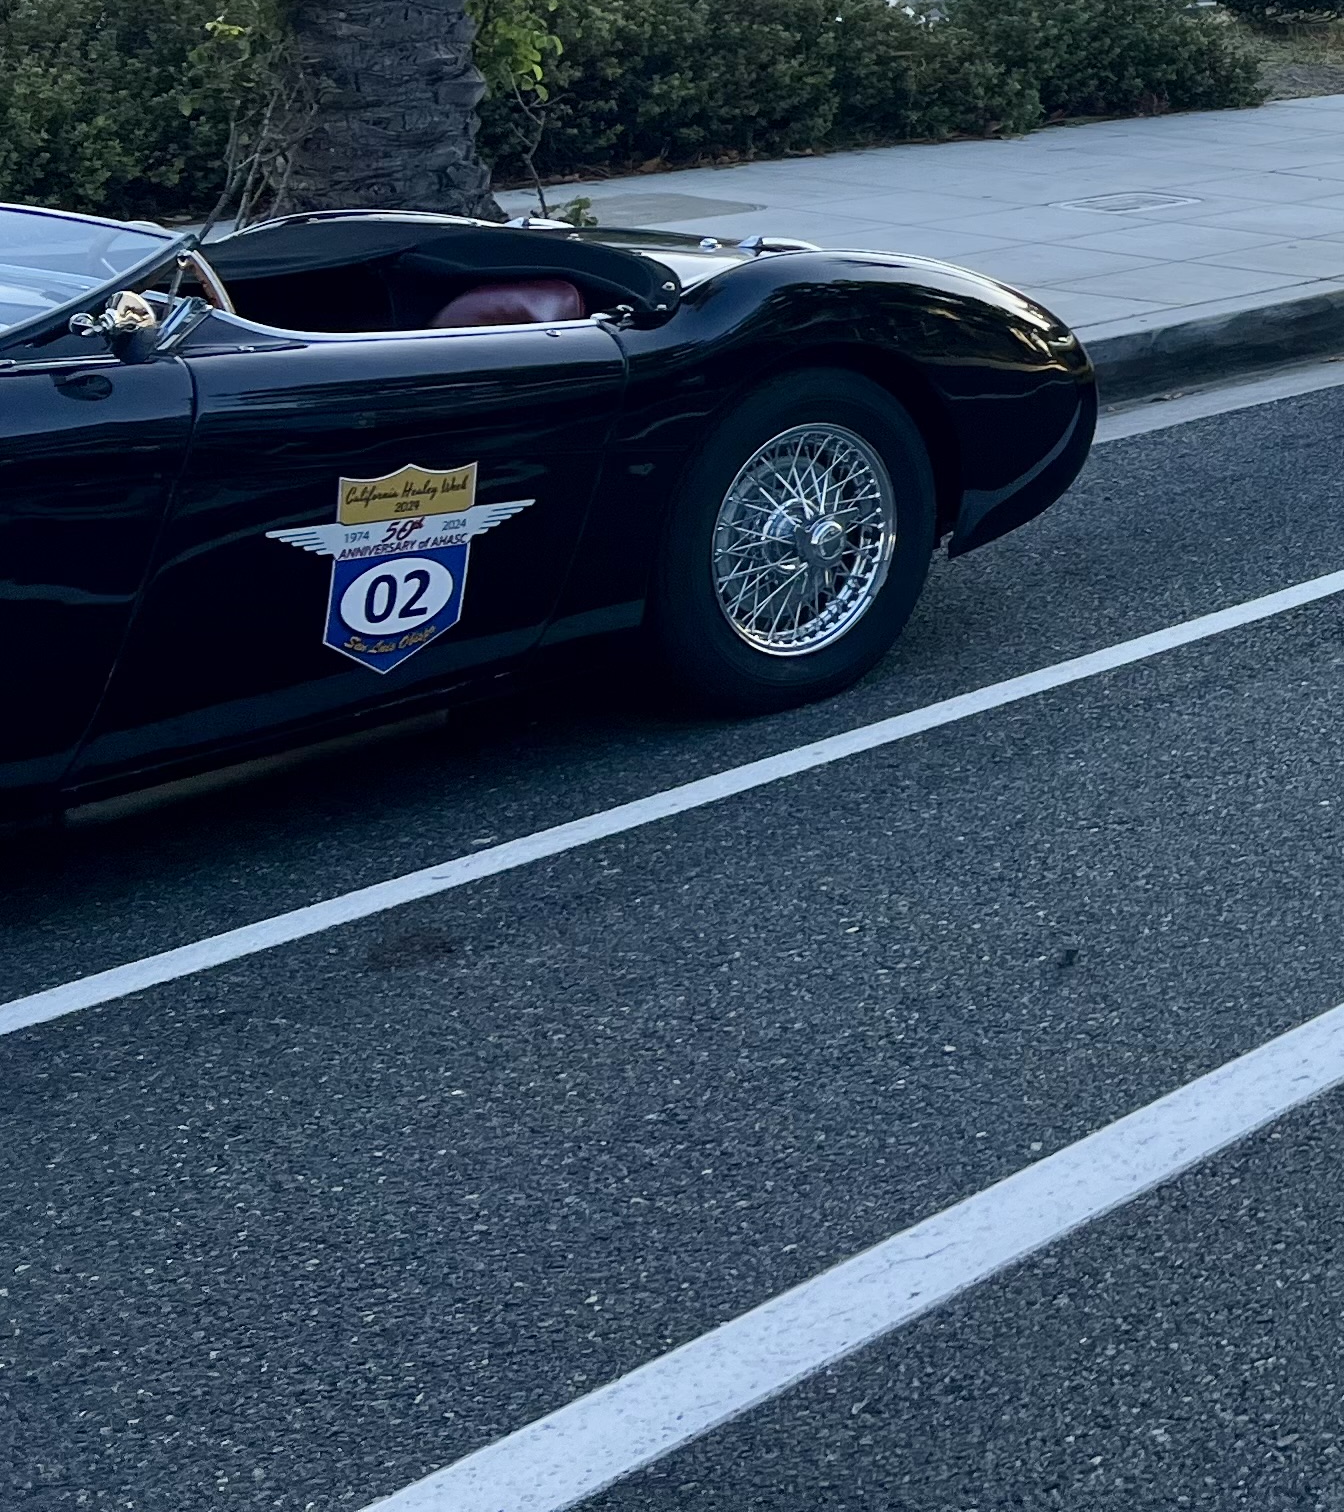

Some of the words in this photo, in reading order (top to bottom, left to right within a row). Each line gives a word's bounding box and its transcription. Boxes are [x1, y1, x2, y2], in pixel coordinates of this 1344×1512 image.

[346, 487, 398, 508] California
[344, 531, 370, 544] 1974
[442, 519, 467, 532] 2024
[339, 541, 416, 560] ANNIVERSARY
[418, 537, 432, 549] of
[364, 569, 431, 624] 02
